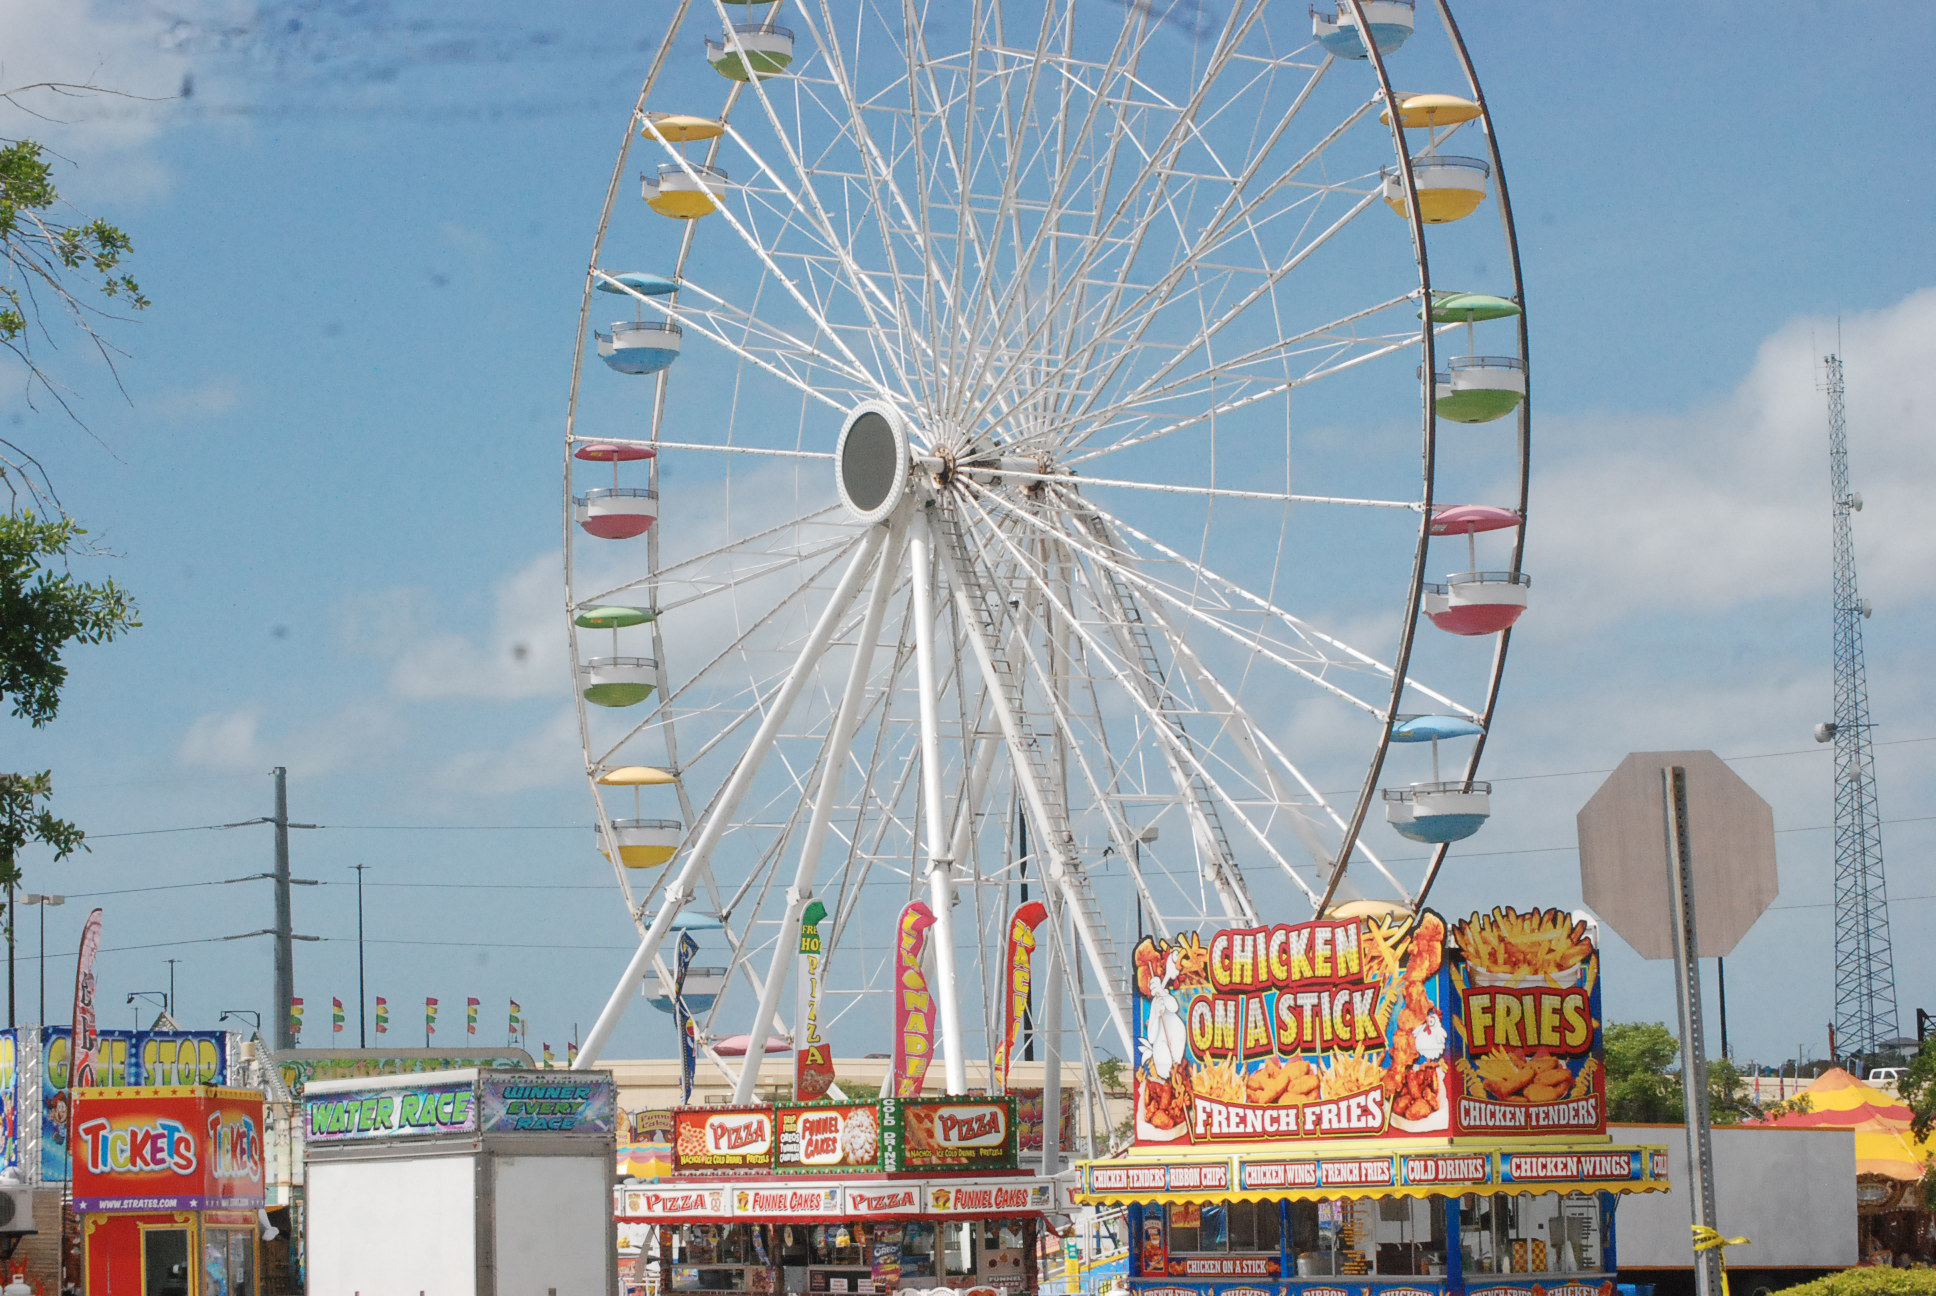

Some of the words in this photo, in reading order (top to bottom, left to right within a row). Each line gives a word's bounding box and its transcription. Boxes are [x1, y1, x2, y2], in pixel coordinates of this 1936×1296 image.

[1212, 923, 1361, 986] CHICKEN
[805, 955, 825, 1065] PIZZA
[1191, 998, 1236, 1051] ON
[1246, 997, 1270, 1050] A
[1278, 988, 1381, 1051] STICK
[1469, 993, 1587, 1048] FRIES
[47, 1036, 127, 1090] GME
[144, 1038, 217, 1086] STOP
[502, 1085, 593, 1099] WINNER
[311, 1096, 395, 1135] WATER
[399, 1091, 473, 1127] RACE
[506, 1101, 584, 1115] EVERY
[883, 1098, 896, 1126] COLD
[1194, 1098, 1297, 1134] FRENCH
[1304, 1090, 1384, 1132] FRIES
[1460, 1099, 1526, 1127] CHICKEN
[1529, 1098, 1597, 1126] TENDERS
[514, 1117, 576, 1131] RACE
[709, 1119, 767, 1150] PIZZA
[801, 1116, 839, 1140] FUNNEL
[938, 1111, 1001, 1141] PIZZA
[81, 1120, 196, 1172] TICKETS
[208, 1113, 260, 1179] TICKETS
[805, 1136, 838, 1159] CAKES
[884, 1132, 896, 1172] DRINKS
[911, 1149, 932, 1158] NACHOS
[936, 1149, 945, 1157] ICE
[945, 1149, 957, 1157] COLD
[959, 1149, 976, 1157] DRINKS
[1093, 1169, 1128, 1189] CHICKEN
[1129, 1168, 1166, 1188] TENDERS
[1170, 1167, 1200, 1188] RIBBON
[1201, 1167, 1227, 1187] CHIPS
[1245, 1165, 1285, 1187] CHICKEN
[1286, 1163, 1316, 1184] WINGS
[1321, 1162, 1360, 1183] FRENCH
[1361, 1160, 1390, 1181] FRIES
[1408, 1158, 1436, 1181] COLD
[1438, 1157, 1484, 1180] DRINKS
[1511, 1155, 1579, 1179] CHICKEN
[1581, 1154, 1629, 1177] WINGS
[99, 1199, 177, 1209] WWW.STRATES.COM
[643, 1193, 707, 1212] PIZZA
[752, 1193, 788, 1211] FUNNEL
[790, 1191, 822, 1211] CAKES
[849, 1191, 915, 1211] PIZZA
[954, 1188, 993, 1210] FUNNEL
[995, 1187, 1028, 1209] CAKES
[874, 1246, 896, 1257] OREO
[1187, 1259, 1222, 1273] CHICKEN
[1222, 1259, 1233, 1273] ON
[1234, 1259, 1242, 1273] A
[1242, 1259, 1267, 1273] STICK
[988, 1275, 1022, 1283] FUNNEL
